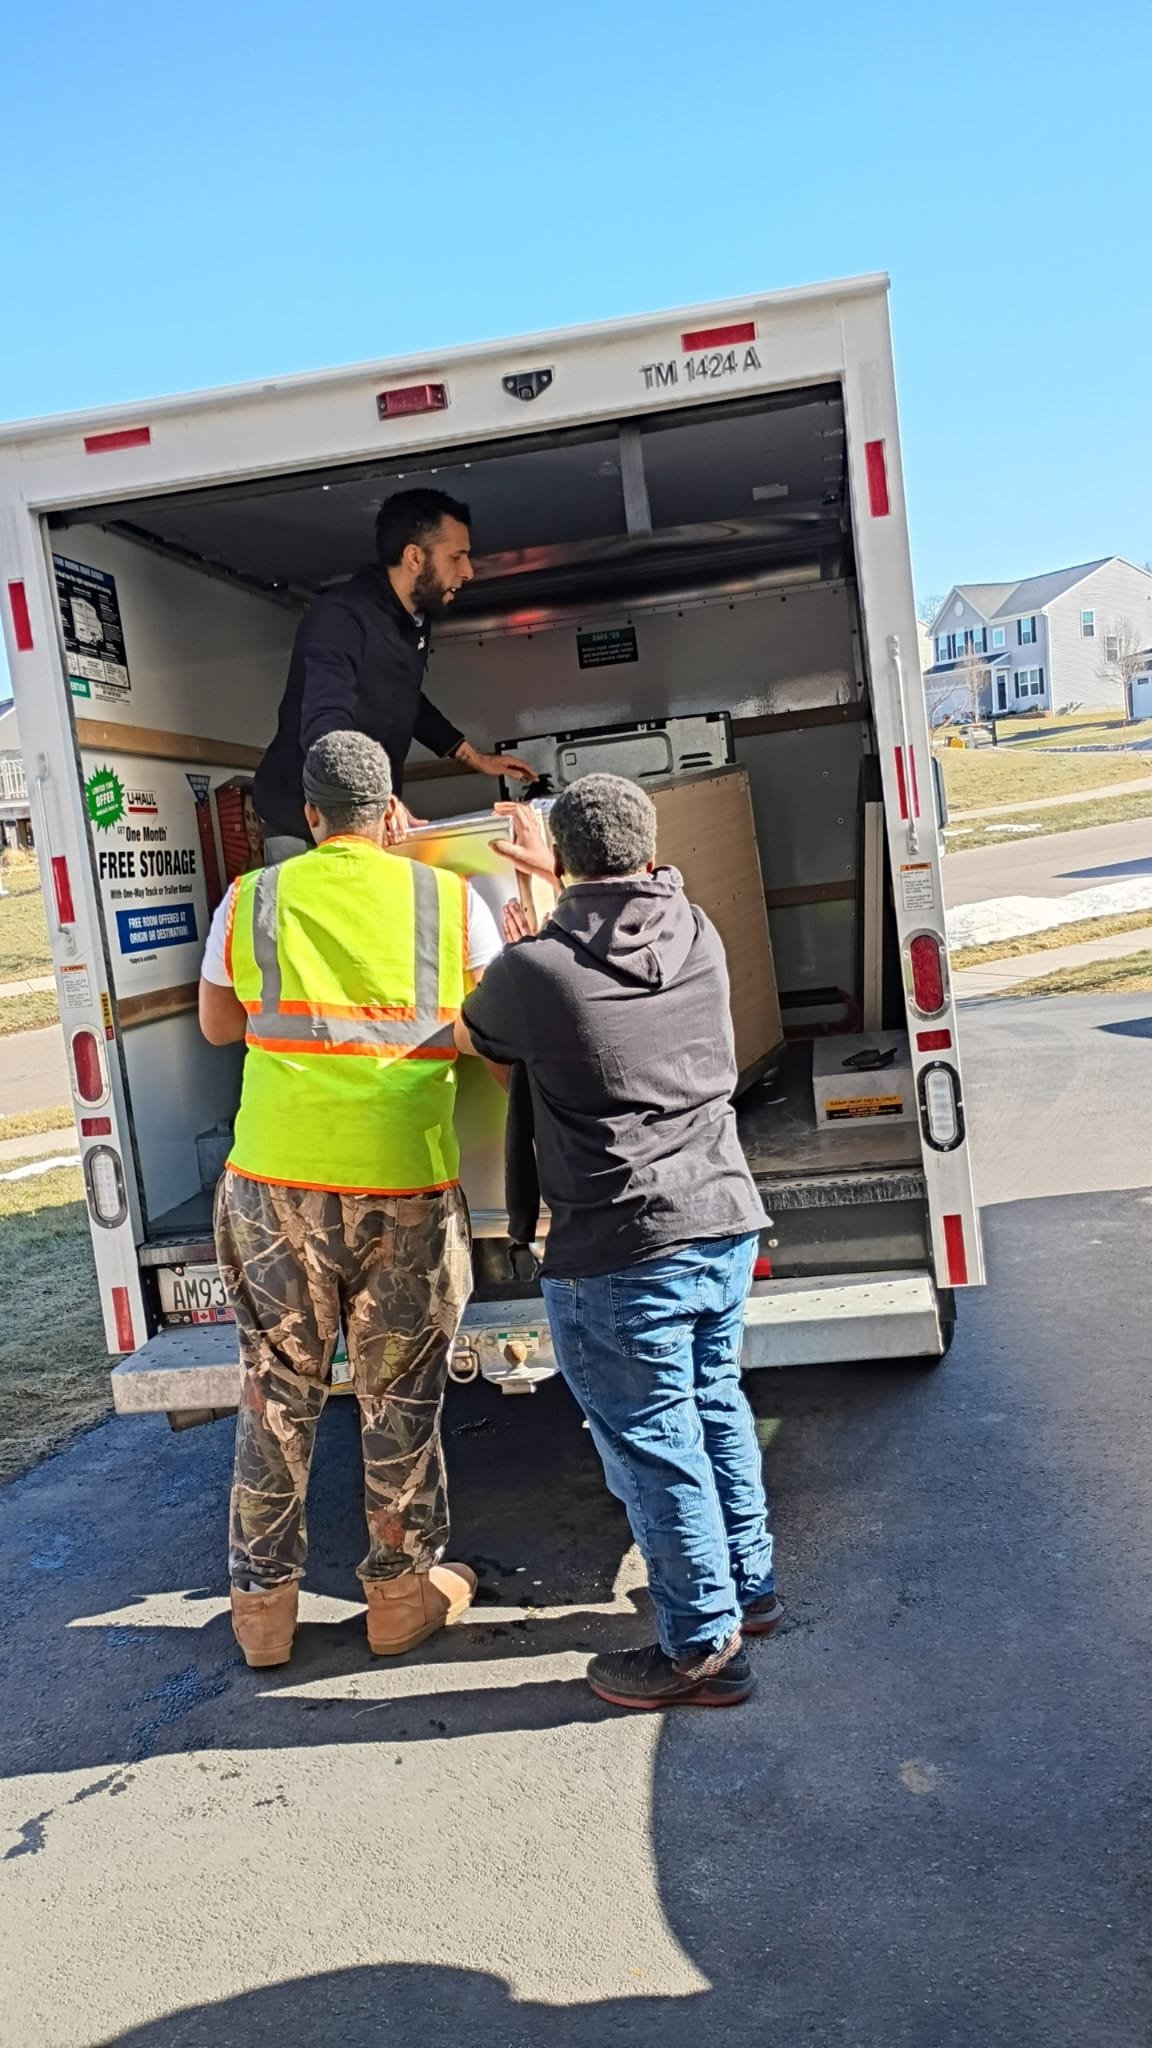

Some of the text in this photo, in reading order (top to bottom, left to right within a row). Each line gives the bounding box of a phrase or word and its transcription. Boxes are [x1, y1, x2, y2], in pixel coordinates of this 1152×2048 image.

[639, 346, 762, 389] TM 1424 A
[95, 790, 115, 808] OFFER
[117, 826, 125, 834] GET
[126, 826, 141, 842] One
[99, 849, 196, 880] FREE STORAGE
[110, 883, 192, 899] With One-Way Truck or Trailer Rental
[128, 917, 142, 929] FREE
[142, 915, 158, 927] ROOM
[158, 912, 179, 925] OFFERED
[129, 931, 148, 944] ORIGIN
[149, 930, 156, 941] OR
[173, 1277, 227, 1310] AM93
